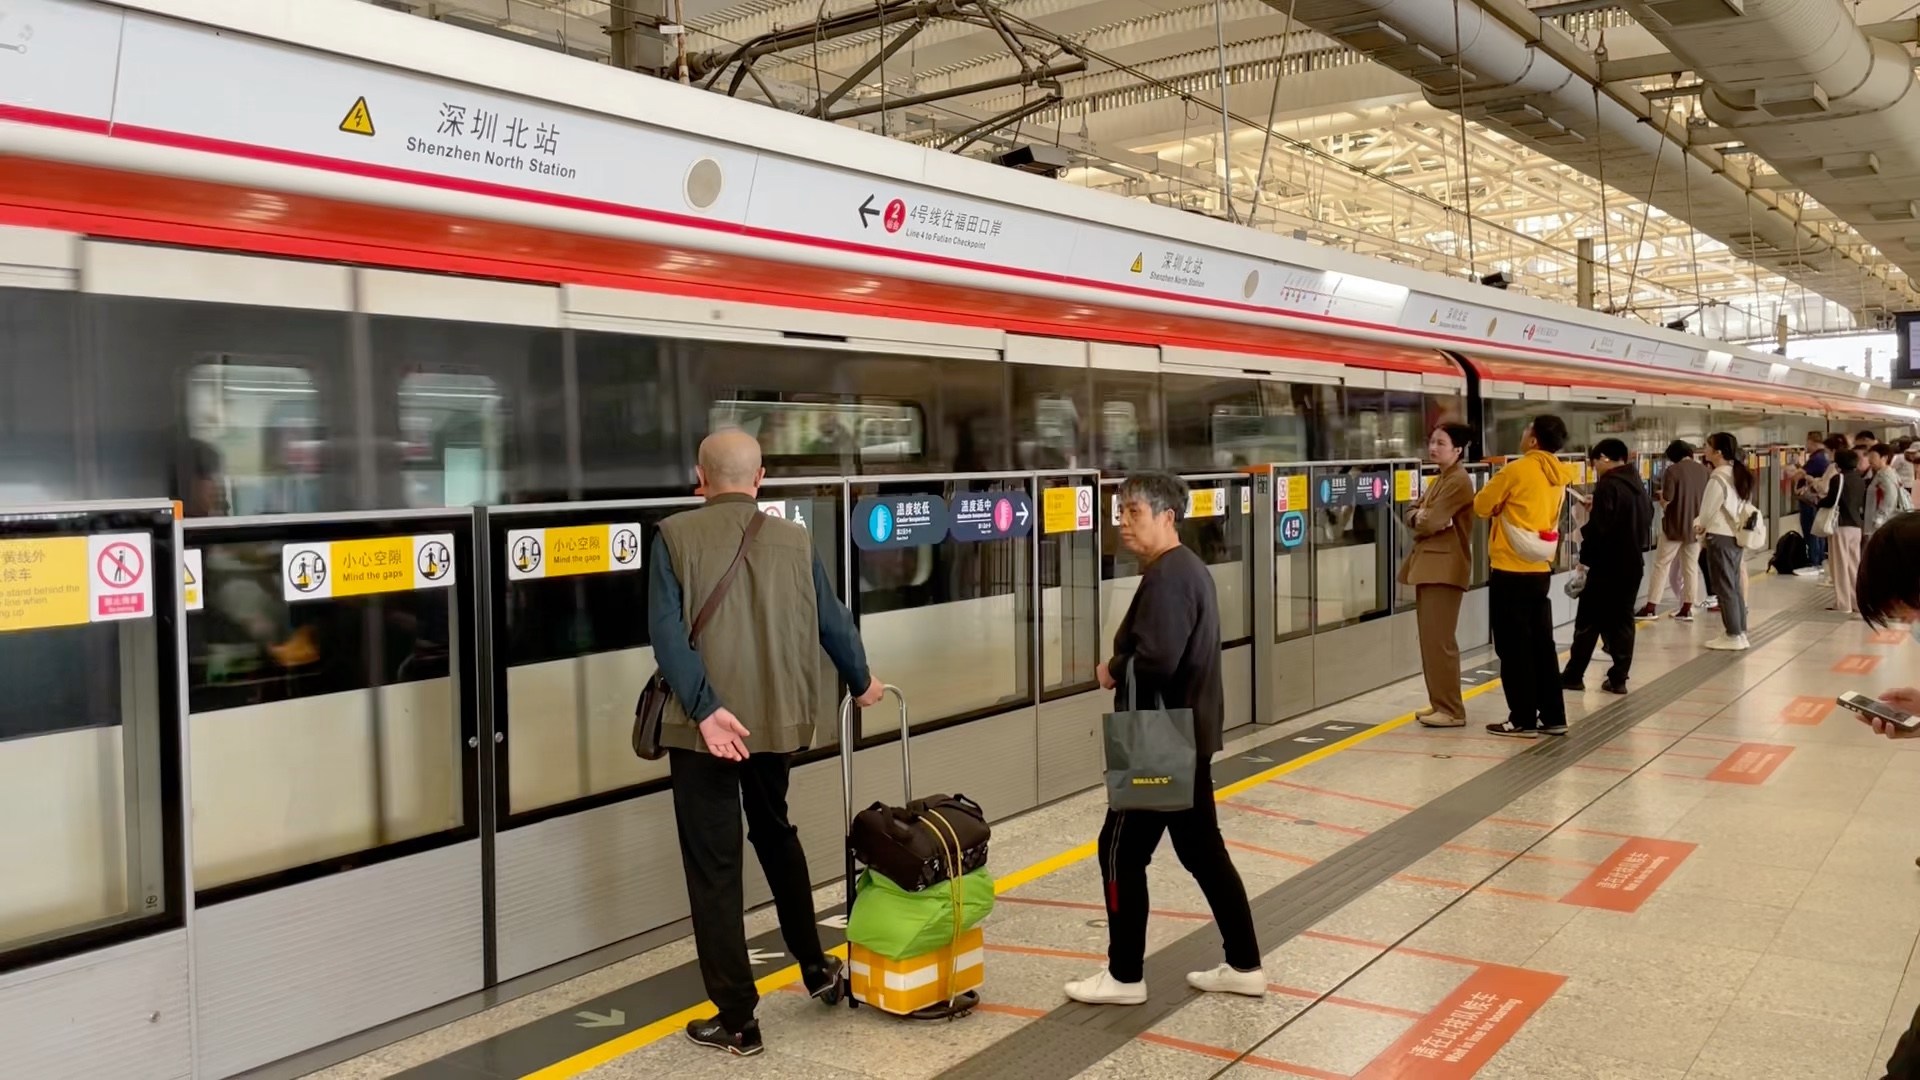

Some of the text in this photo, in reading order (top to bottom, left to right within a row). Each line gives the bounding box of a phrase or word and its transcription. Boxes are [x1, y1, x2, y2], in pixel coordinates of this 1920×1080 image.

[437, 102, 560, 156] 深圳北站
[406, 136, 577, 179] Shenzhen North Station
[891, 203, 900, 219] 2
[909, 204, 1003, 238] 4号线往福田口岸
[905, 228, 920, 238] Line
[932, 233, 952, 244] Futian
[952, 236, 986, 250] Checkpoint
[1161, 251, 1203, 276] 深圳北站
[1149, 271, 1174, 282] Shenzhen
[896, 501, 930, 516] 温度较低
[961, 498, 991, 512] 温度适中
[1285, 520, 1291, 538] 4
[553, 536, 601, 553] 小心空隙
[343, 549, 402, 569] 小心空隙
[553, 554, 601, 564] Mind the gaps
[0, 568, 32, 583] 候车
[342, 569, 403, 582] Mind the gaps
[6, 587, 32, 598] stand
[34, 585, 64, 596] behind
[65, 584, 80, 593] the
[23, 597, 48, 606] when
[1408, 991, 1499, 1059] 请在此排队候车
[1442, 1048, 1469, 1063] Wait
[1464, 1031, 1487, 1043] line
[1485, 998, 1524, 1023] boarding
